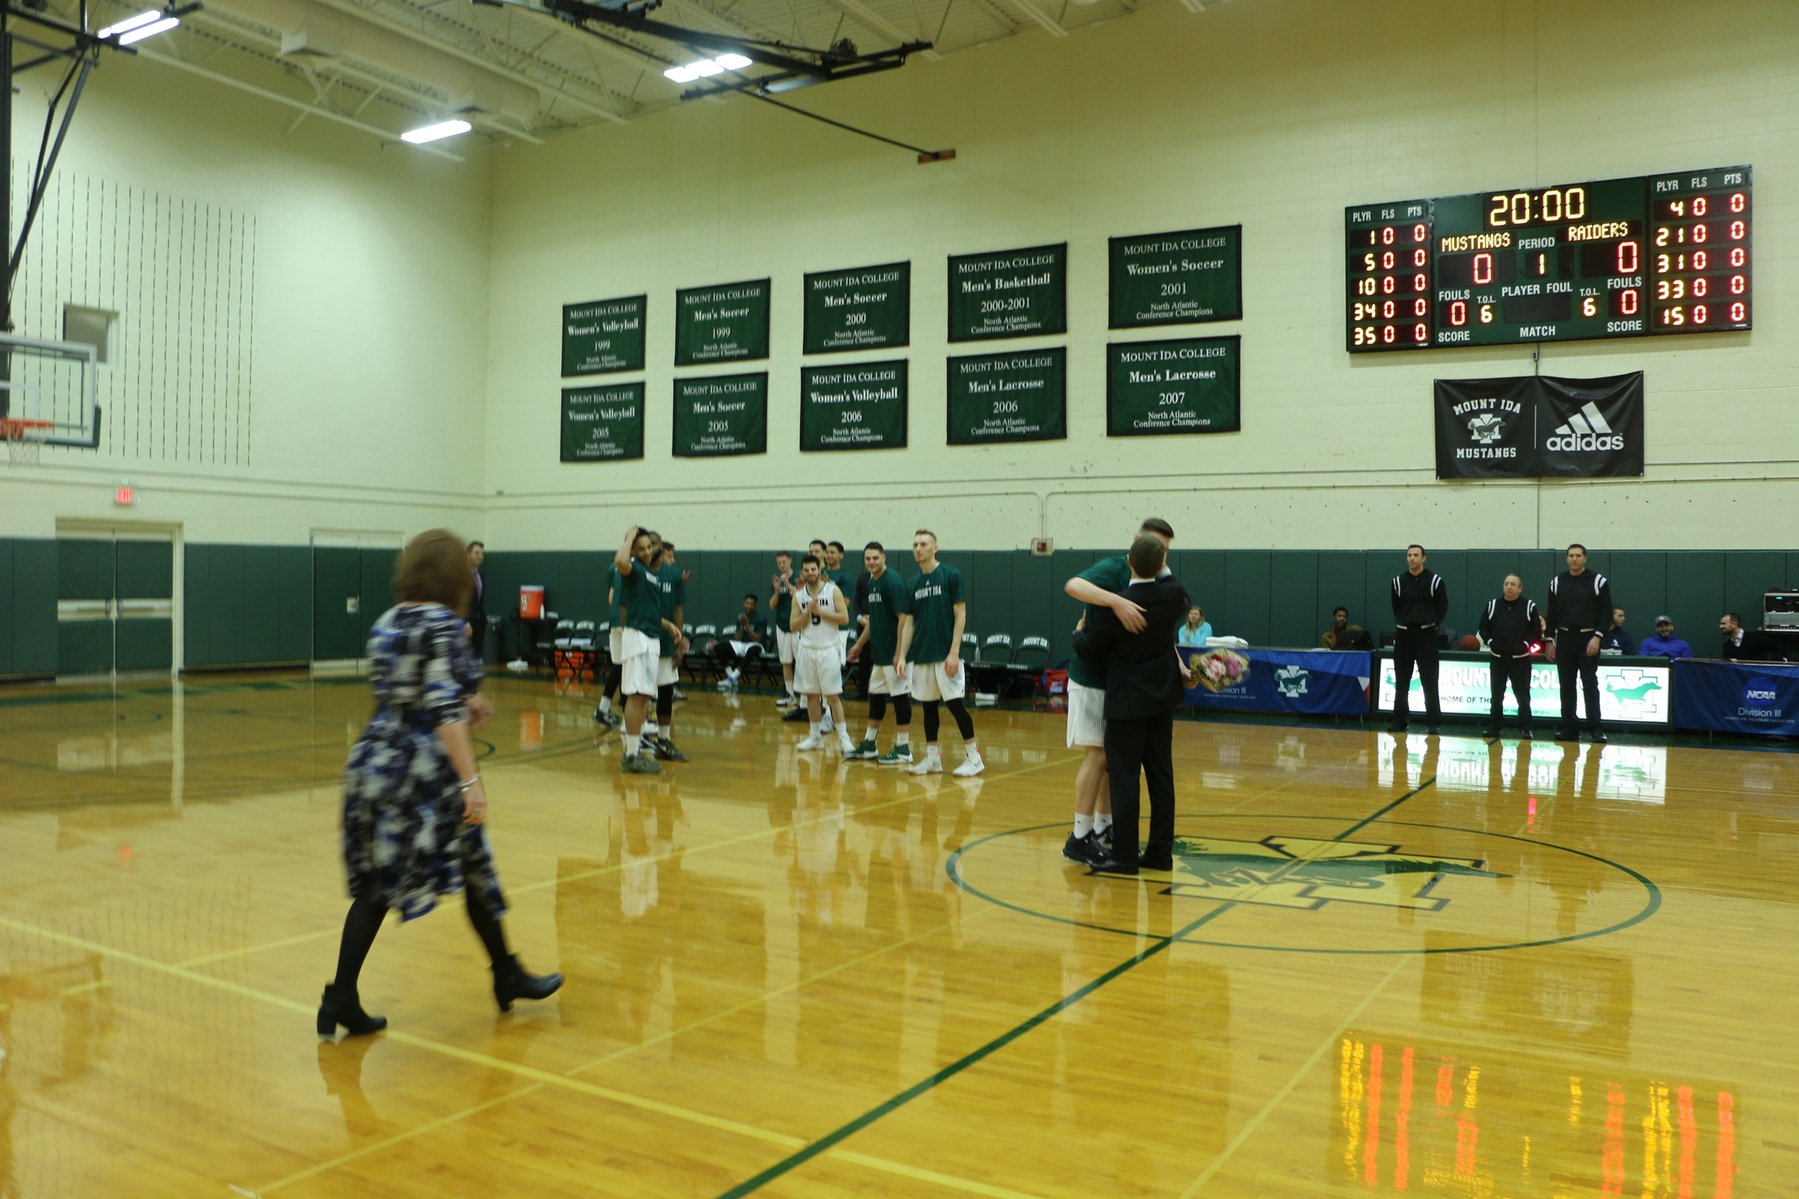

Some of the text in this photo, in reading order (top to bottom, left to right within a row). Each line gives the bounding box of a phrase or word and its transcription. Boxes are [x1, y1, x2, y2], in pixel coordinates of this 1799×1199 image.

[1657, 174, 1741, 192] PLYR FLS PTS
[1490, 188, 1584, 226] 20:00
[1670, 194, 1744, 216] 4 0 0
[1353, 206, 1422, 222] PLYR FLS PTS
[1371, 224, 1425, 244] 1 0 0
[1568, 222, 1628, 242] RAIDERS
[1656, 221, 1744, 246] 21 0 0
[1124, 238, 1226, 256] MOUNT IDA COLLEGE
[1442, 232, 1510, 252] MUSTANGS
[1518, 237, 1554, 249] PERIOD
[959, 254, 1054, 273] MOUNT IDA COLLEGE
[1364, 249, 1425, 271] 5 0 0
[1540, 254, 1544, 274] 1
[1618, 242, 1638, 272] 0
[1658, 248, 1744, 273] 31 0 0
[1127, 258, 1224, 276] Women's Soccer
[1474, 254, 1492, 284] 0
[814, 272, 899, 289] MOUNT IDA COLLEGE
[962, 273, 1050, 293] Men's Basketball
[1358, 274, 1426, 295] 10 0 0
[1608, 277, 1642, 289] FOULS
[1658, 276, 1744, 300] 33 0 0
[685, 288, 760, 305] MOUNT IDA COLLEGE
[1161, 283, 1186, 296] 2001
[1439, 290, 1470, 301] FOULS
[1502, 282, 1572, 297] PLAYER FOUL
[1580, 288, 1600, 296] T.O.L.
[824, 292, 887, 308] Men's Soccer
[981, 298, 1030, 312] 2000-2001
[1150, 300, 1198, 310] North Atlantic
[1477, 296, 1496, 304] T.O.L.
[1584, 298, 1596, 316] 6
[1622, 290, 1636, 314] 0
[694, 308, 749, 321] Men's Soccer
[1136, 308, 1213, 320] Conference Champions
[1354, 299, 1426, 320] 34 0 0
[1452, 302, 1465, 326] 0
[1480, 305, 1492, 323] 6
[1664, 302, 1744, 326] 15 0 0
[846, 314, 866, 325] 2000
[984, 315, 1028, 326] North Atlantic
[1608, 320, 1642, 332] SCORE
[568, 319, 638, 336] Women's Volleyball
[713, 327, 730, 339] 1999
[971, 321, 1041, 334] Conference Champions
[1354, 324, 1426, 345] 35 0 0
[1520, 326, 1556, 338] MATCH
[1438, 331, 1470, 342] SCORE
[1121, 348, 1226, 362] MOUNT IDA COLLEGE
[960, 357, 1052, 374] MOUNT IDA COLLEGE
[812, 371, 896, 384] MOUNT IDA COLLEGE
[1129, 369, 1216, 383] Men's Lacrosse
[684, 382, 757, 396] MOUNT IDA COLLEGE
[969, 378, 1044, 393] Men's Lacrosse
[810, 388, 898, 404] Women's Volleyball
[1159, 392, 1185, 405] 2007
[569, 407, 635, 422] Women's Volleyball
[694, 402, 746, 414] Men's Soccer
[993, 402, 1018, 414] 2006
[1453, 398, 1521, 416] MOUNT IDA
[841, 412, 862, 423] 2006
[984, 417, 1026, 428] North Atlantic
[1148, 410, 1196, 420] North Atlantic
[971, 424, 1040, 436] Conference Champions
[1134, 418, 1210, 428] Conference Champions
[1546, 432, 1624, 452] adidas
[1456, 448, 1516, 458] MUSTANGS
[1746, 690, 1776, 699] NCAA
[1738, 707, 1772, 716] Division
